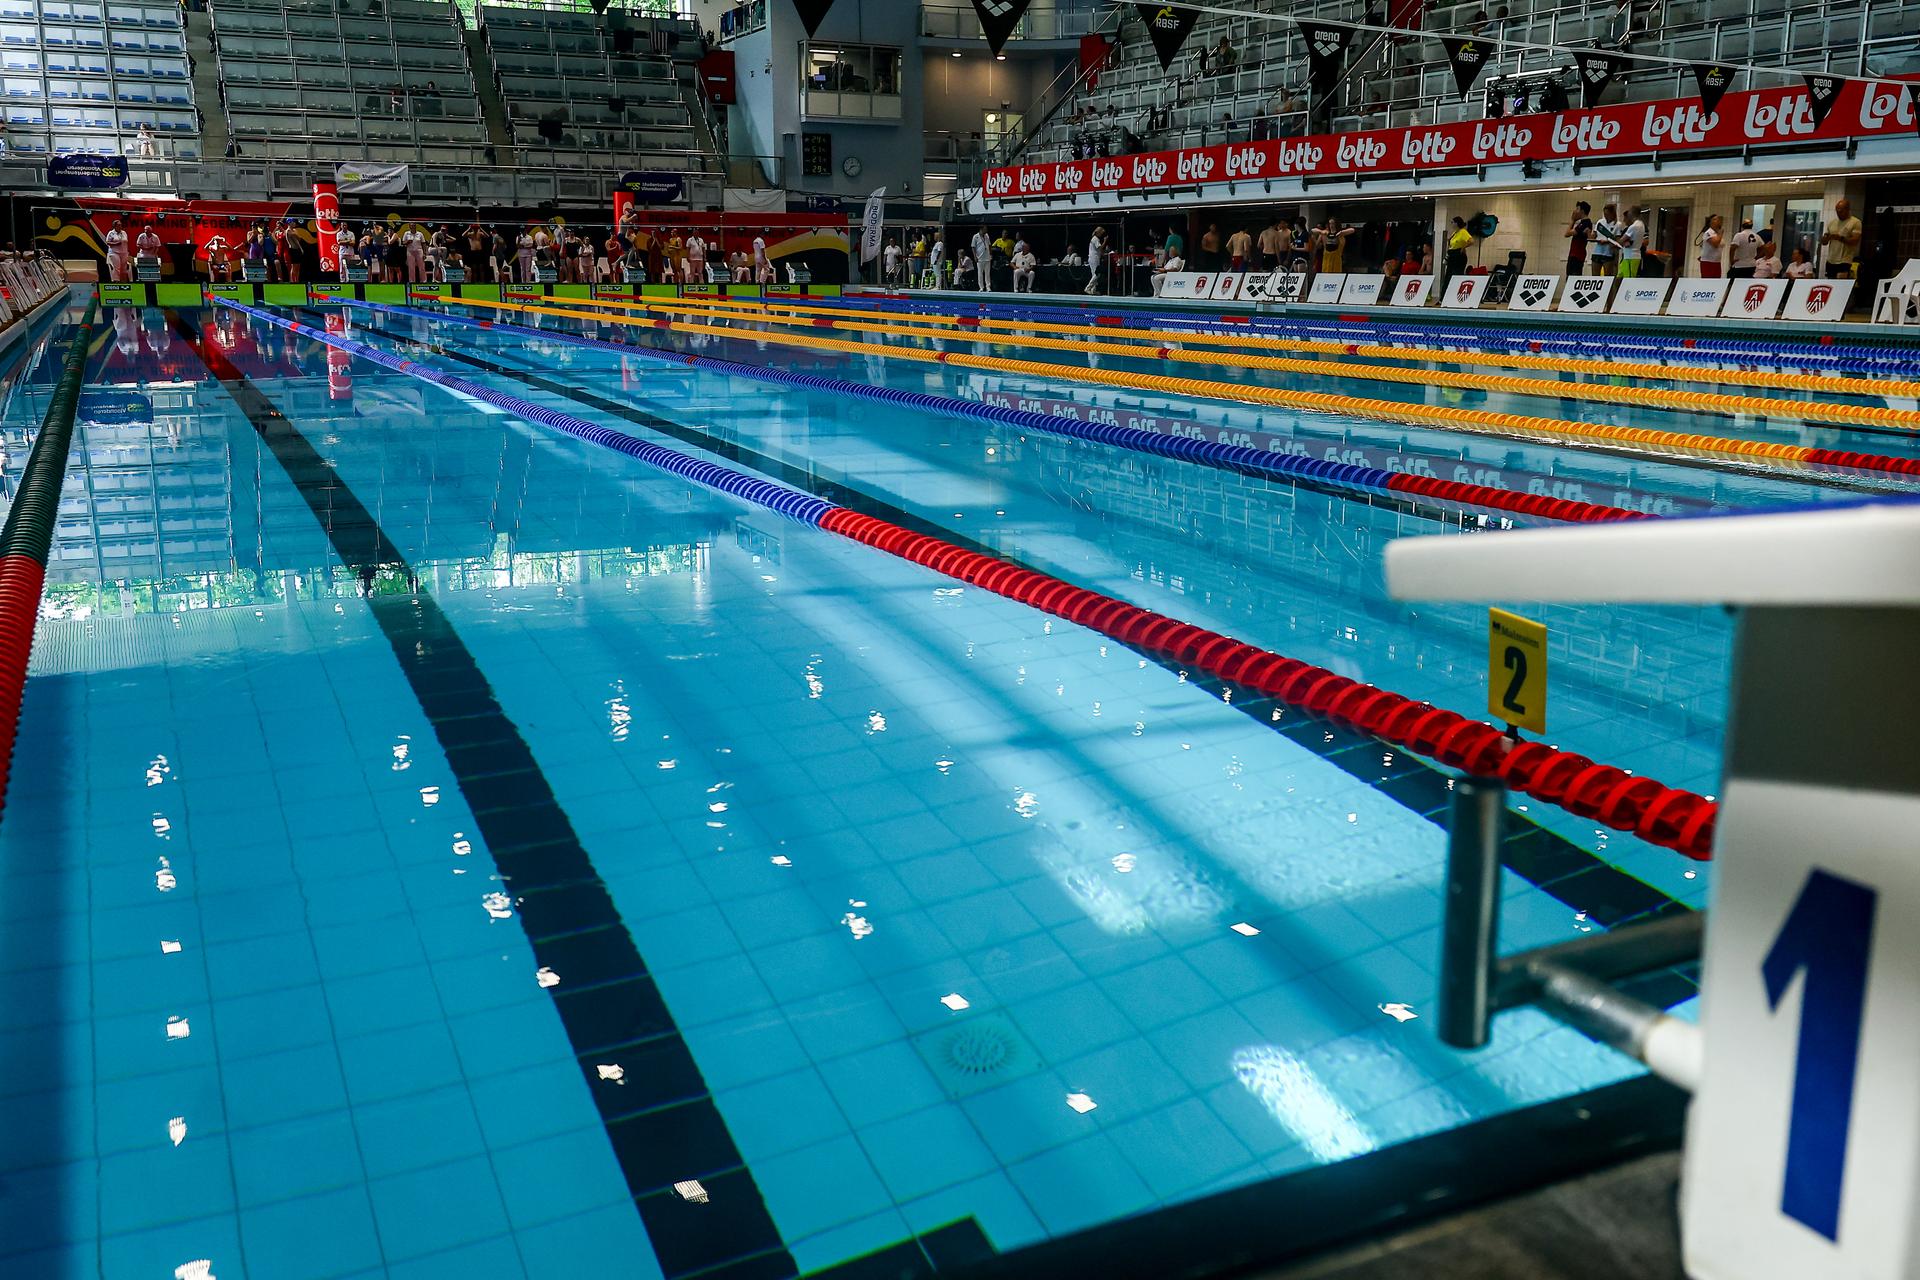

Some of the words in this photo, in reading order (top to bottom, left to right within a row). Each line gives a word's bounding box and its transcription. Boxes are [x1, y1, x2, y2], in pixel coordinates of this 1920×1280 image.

[1156, 18, 1180, 30] RBSF
[1314, 30, 1340, 42] arena
[1458, 52, 1480, 63] RBSF
[1586, 59, 1608, 70] arena
[1705, 77, 1725, 87] RBSF
[1813, 77, 1832, 88] arena
[868, 205, 879, 247] BIODERMA
[1523, 279, 1550, 290] arena
[1574, 279, 1604, 291] arena
[1502, 645, 1527, 716] 2
[1762, 867, 1877, 1243] 1
